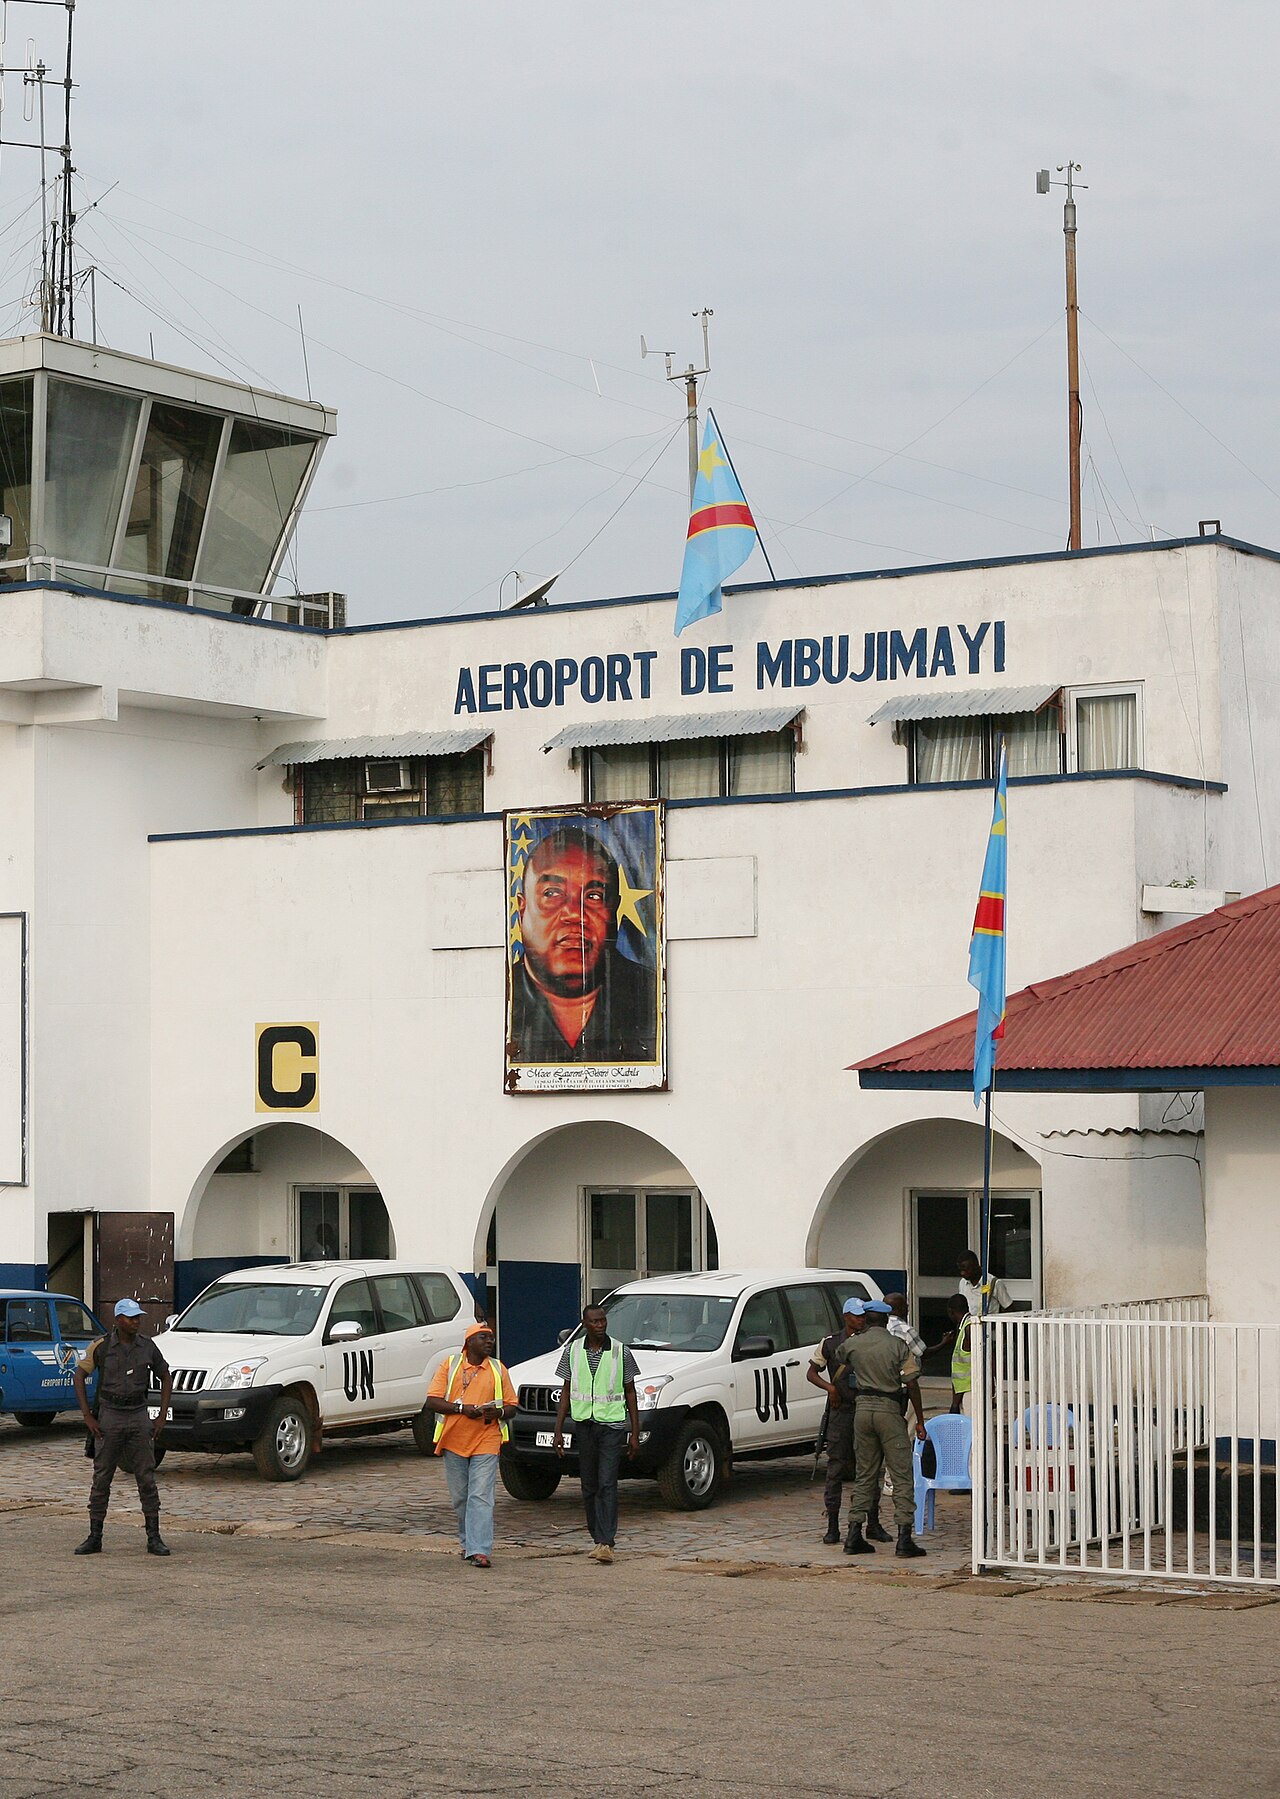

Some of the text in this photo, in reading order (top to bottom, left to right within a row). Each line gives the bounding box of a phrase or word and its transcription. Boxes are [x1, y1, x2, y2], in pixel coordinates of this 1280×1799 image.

[454, 620, 1005, 714] AEROPORT DE MBUJIMAYI
[258, 1026, 316, 1108] C
[343, 1349, 374, 1401] UN
[754, 1366, 788, 1423] UN
